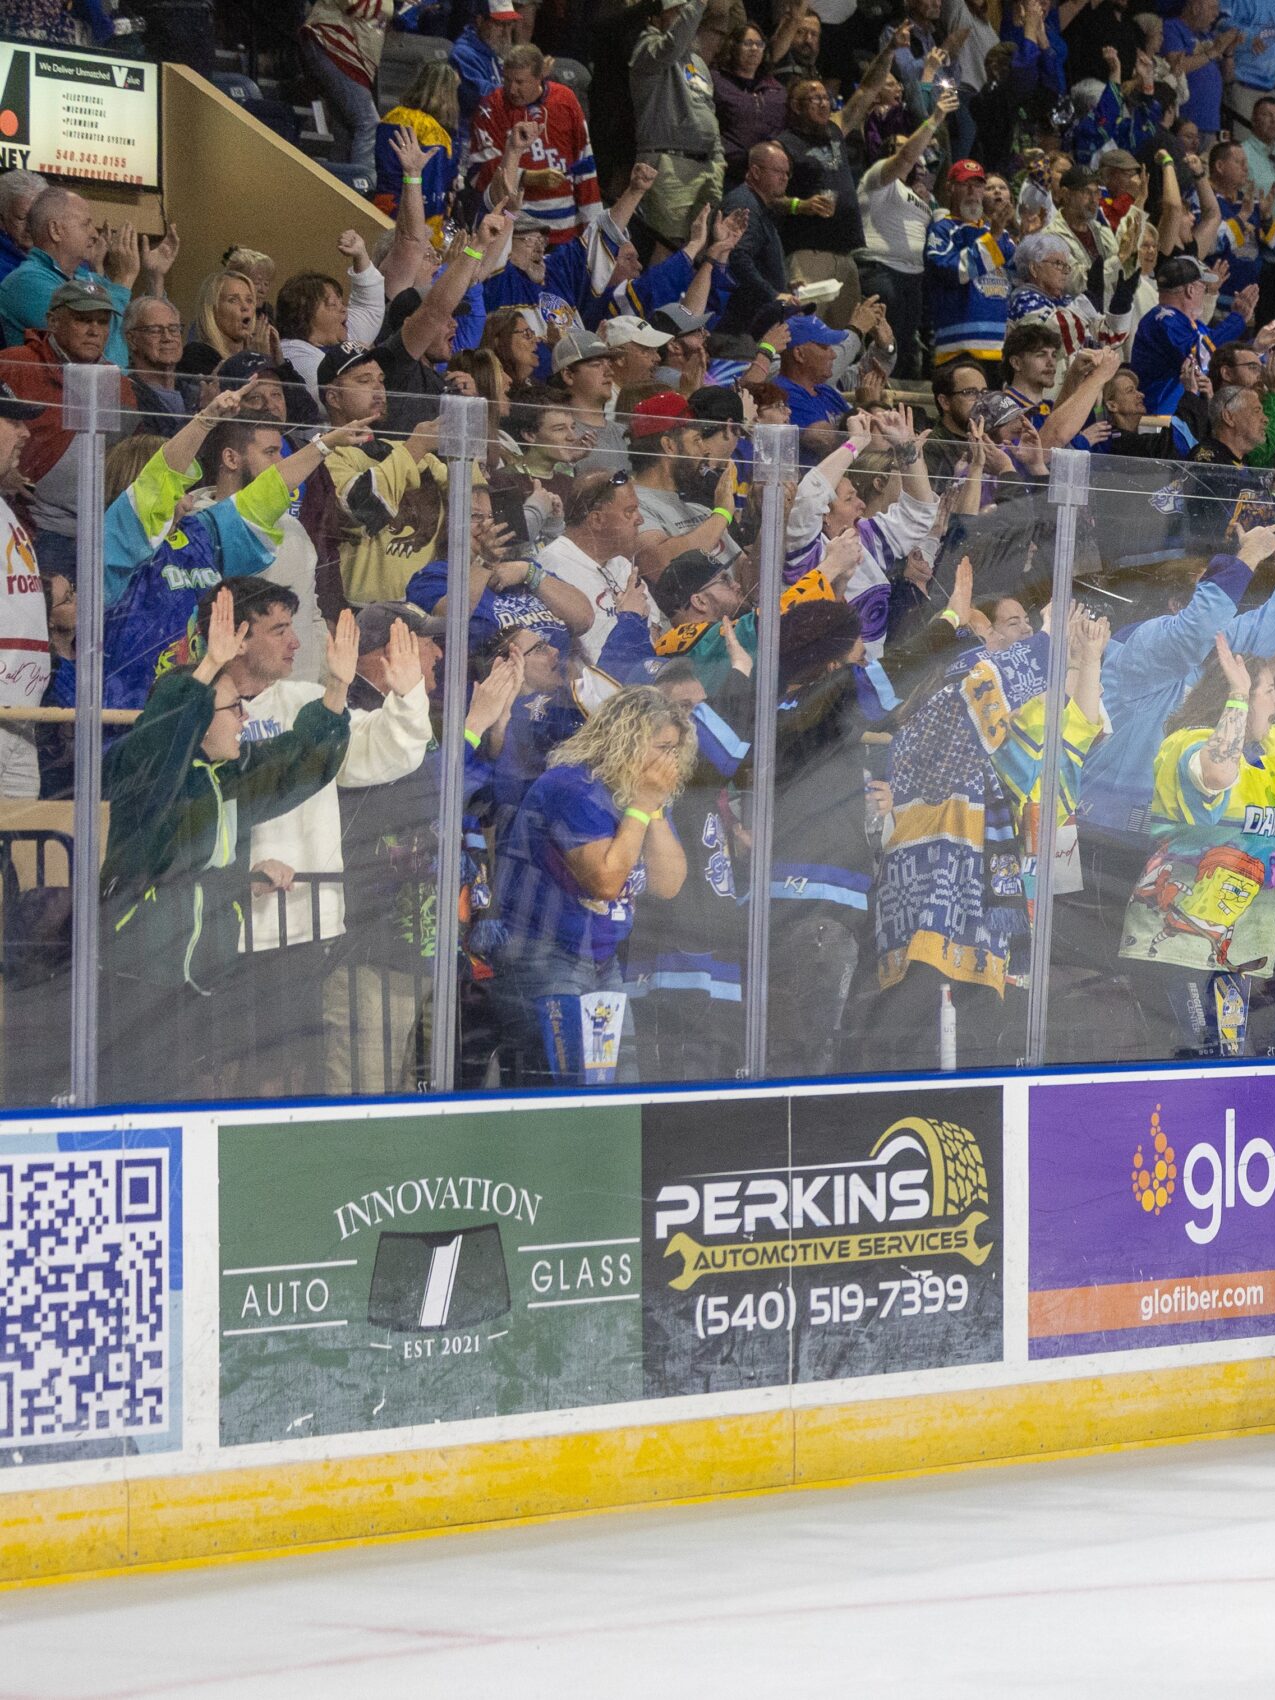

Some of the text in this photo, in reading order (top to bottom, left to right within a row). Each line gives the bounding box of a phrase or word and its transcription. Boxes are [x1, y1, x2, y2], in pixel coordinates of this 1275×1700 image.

[39, 62, 52, 70] We
[52, 65, 75, 75] Deliver
[76, 67, 111, 80] Unmatched
[66, 93, 104, 105] ELECTRICAL
[66, 105, 107, 118] MECHANICAL
[66, 118, 99, 129] PLUMBING
[66, 131, 136, 147] INTEGRATED SYSTEMS
[56, 149, 127, 168] 540.343.0155
[333, 1176, 543, 1241] INNOVATION
[655, 1168, 931, 1240] PERKINS
[693, 1229, 969, 1271] AUTOMOTIVE SERVICES
[531, 1252, 632, 1293] GLASS
[241, 1278, 330, 1319] AUTO
[695, 1274, 969, 1340] (540) 519-7399
[1140, 1282, 1265, 1321] glofiber.com
[403, 1334, 482, 1360] EST 2021
